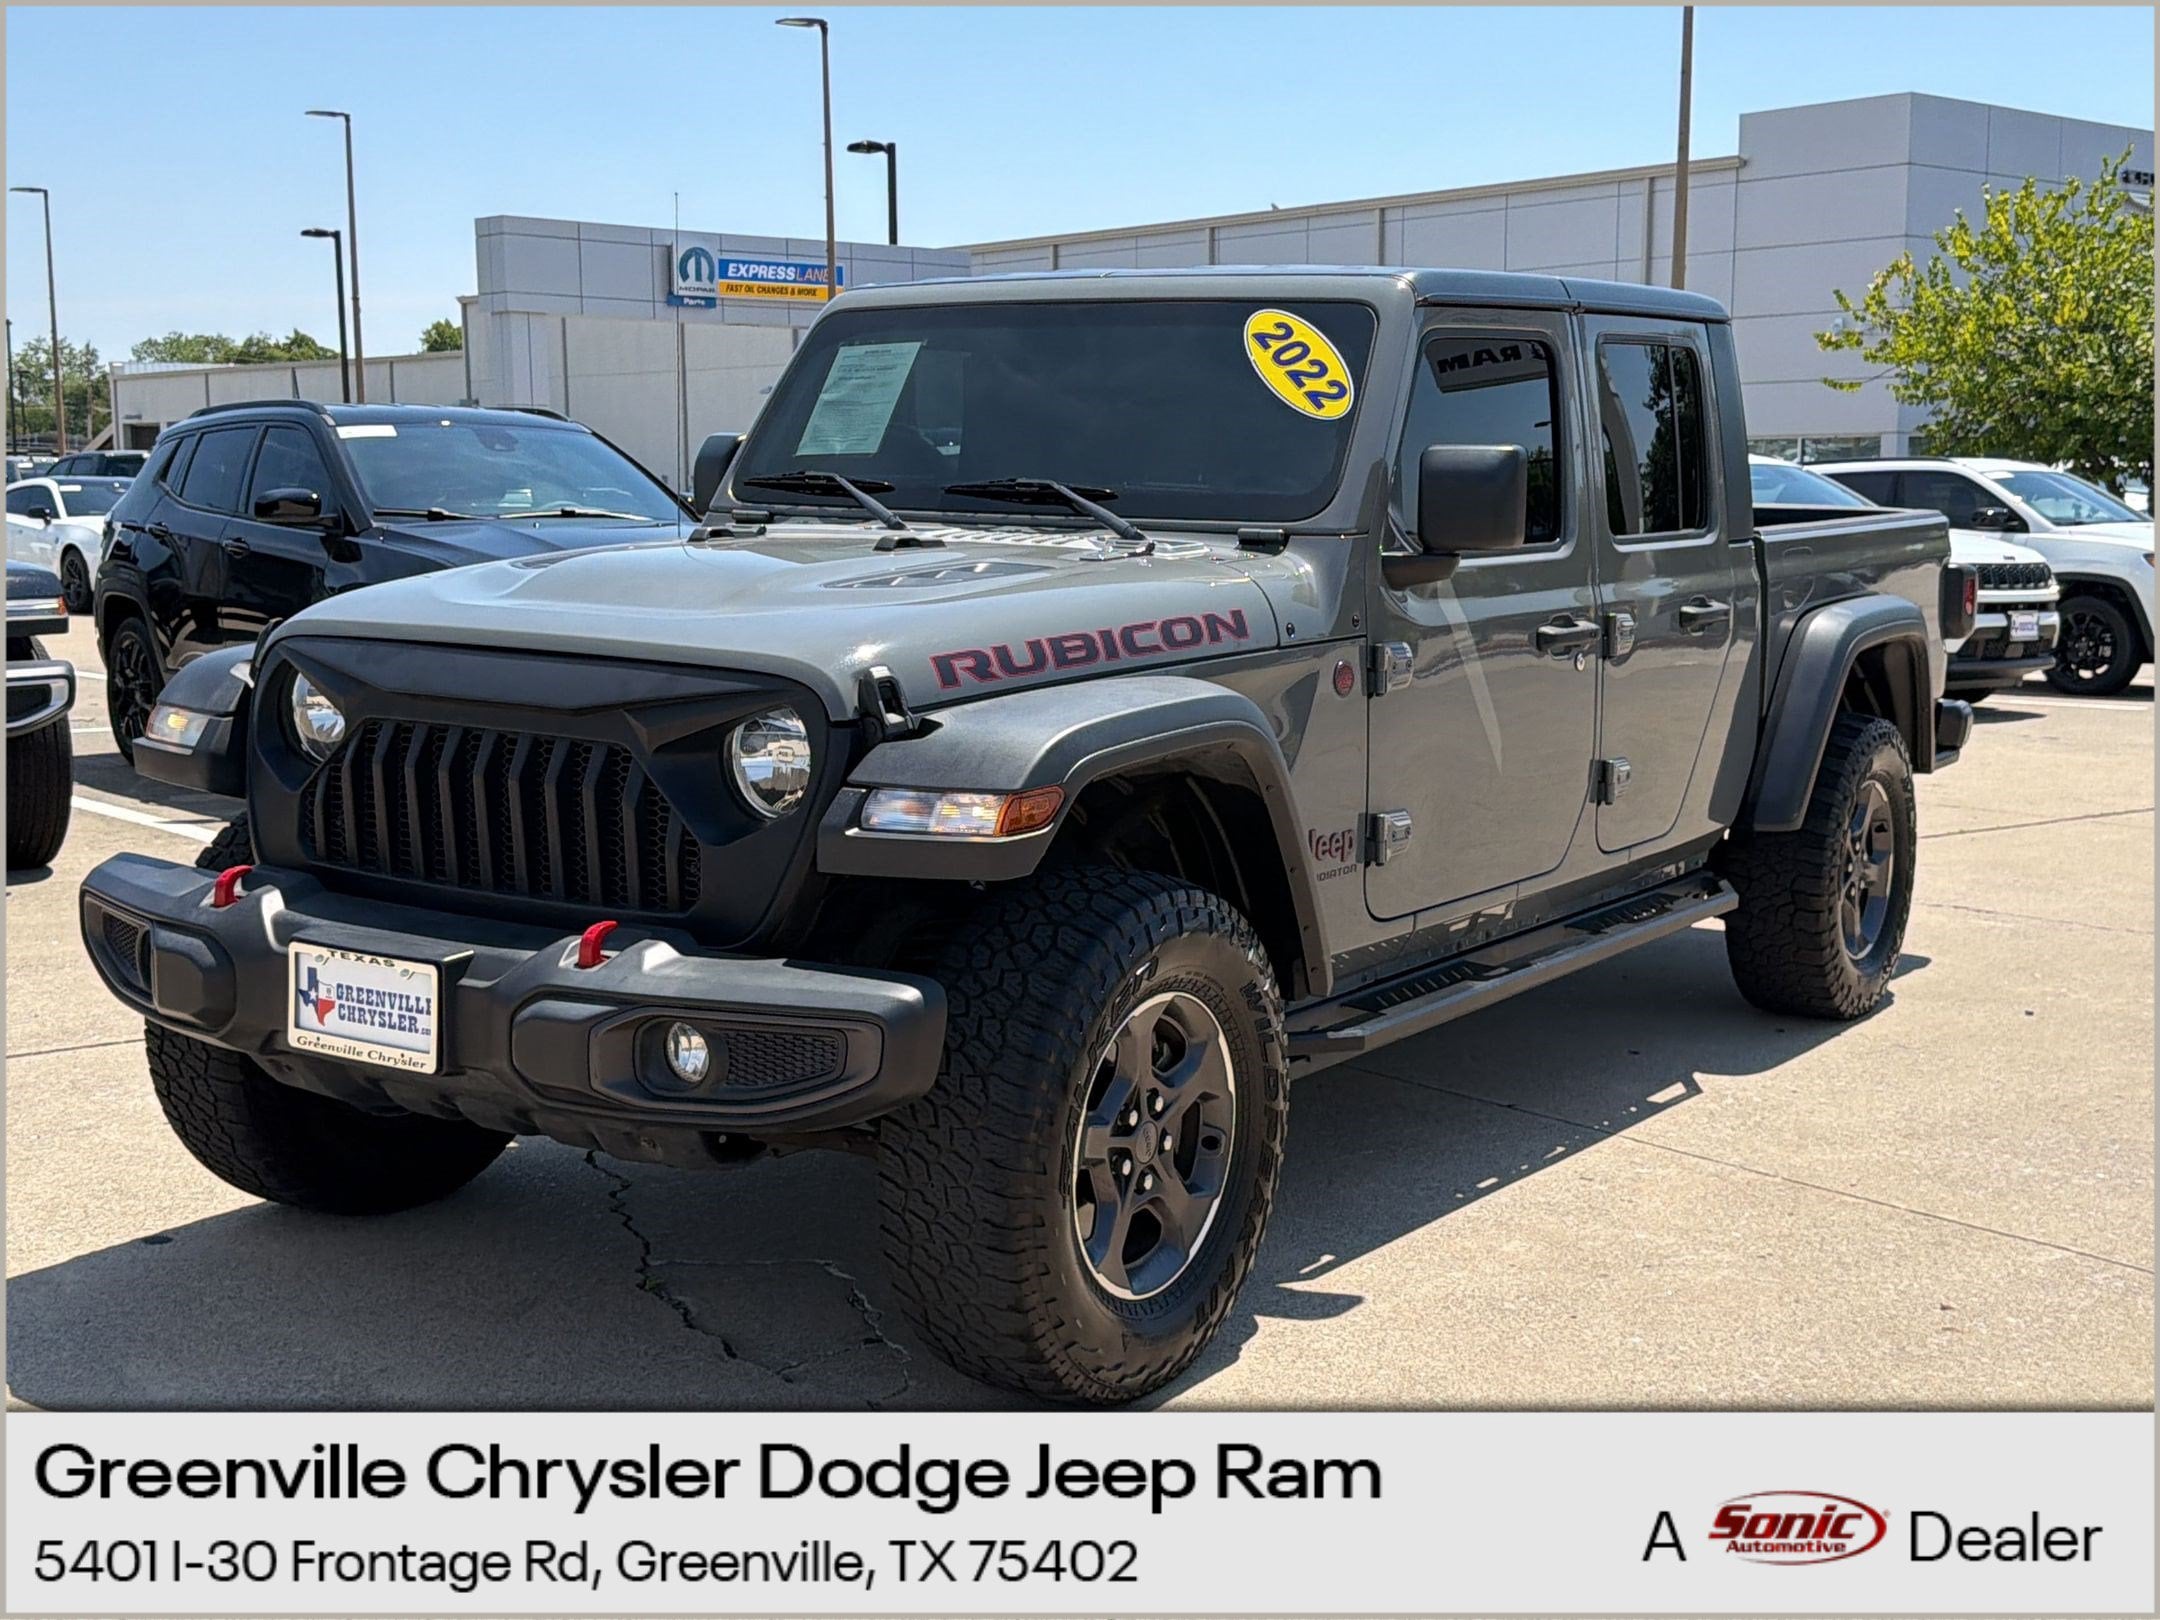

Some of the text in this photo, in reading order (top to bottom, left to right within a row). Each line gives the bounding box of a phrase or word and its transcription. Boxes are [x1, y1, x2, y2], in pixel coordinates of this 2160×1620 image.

[725, 284, 744, 293] FAST
[756, 285, 789, 296] CHANGES
[1250, 321, 1349, 411] 2022
[929, 607, 1249, 690] RUBICON
[327, 949, 396, 968] TEXAS
[296, 1035, 427, 1070] Greenville Chrysler
